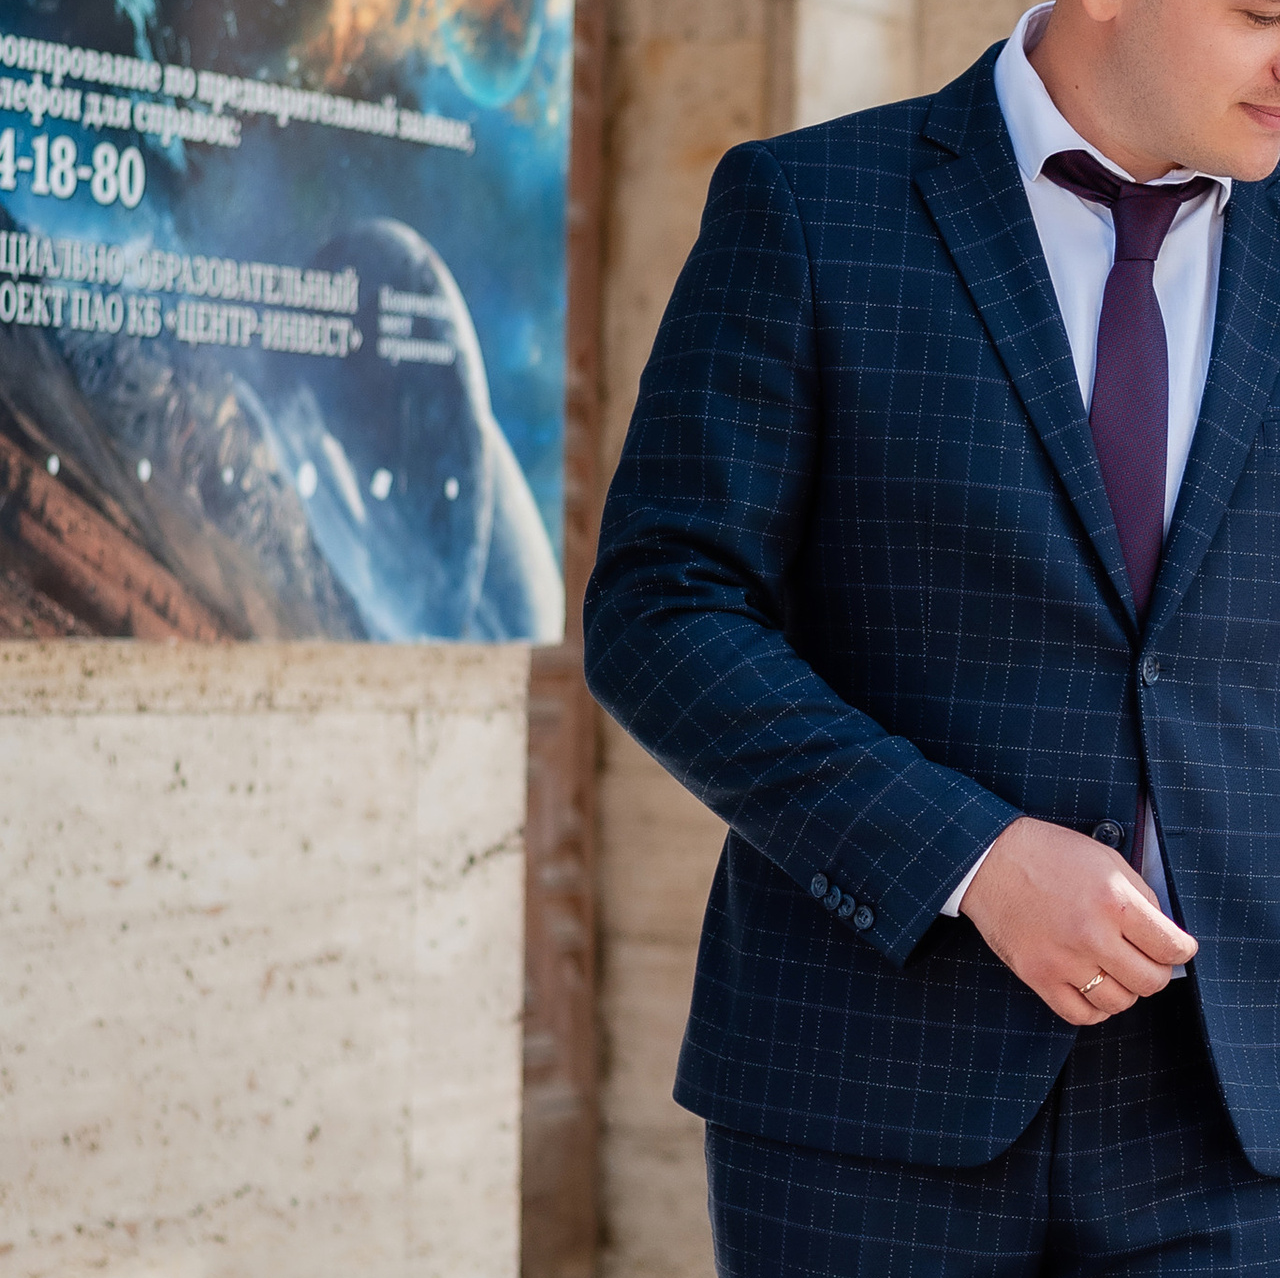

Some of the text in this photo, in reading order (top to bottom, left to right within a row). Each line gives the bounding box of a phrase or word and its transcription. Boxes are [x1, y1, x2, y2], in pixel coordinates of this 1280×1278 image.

[0, 32, 163, 95] онирование
[163, 63, 197, 100] по
[197, 70, 399, 139] предварительной
[82, 91, 132, 132] для
[70, 287, 125, 335] ПАО
[126, 293, 163, 338] КБ
